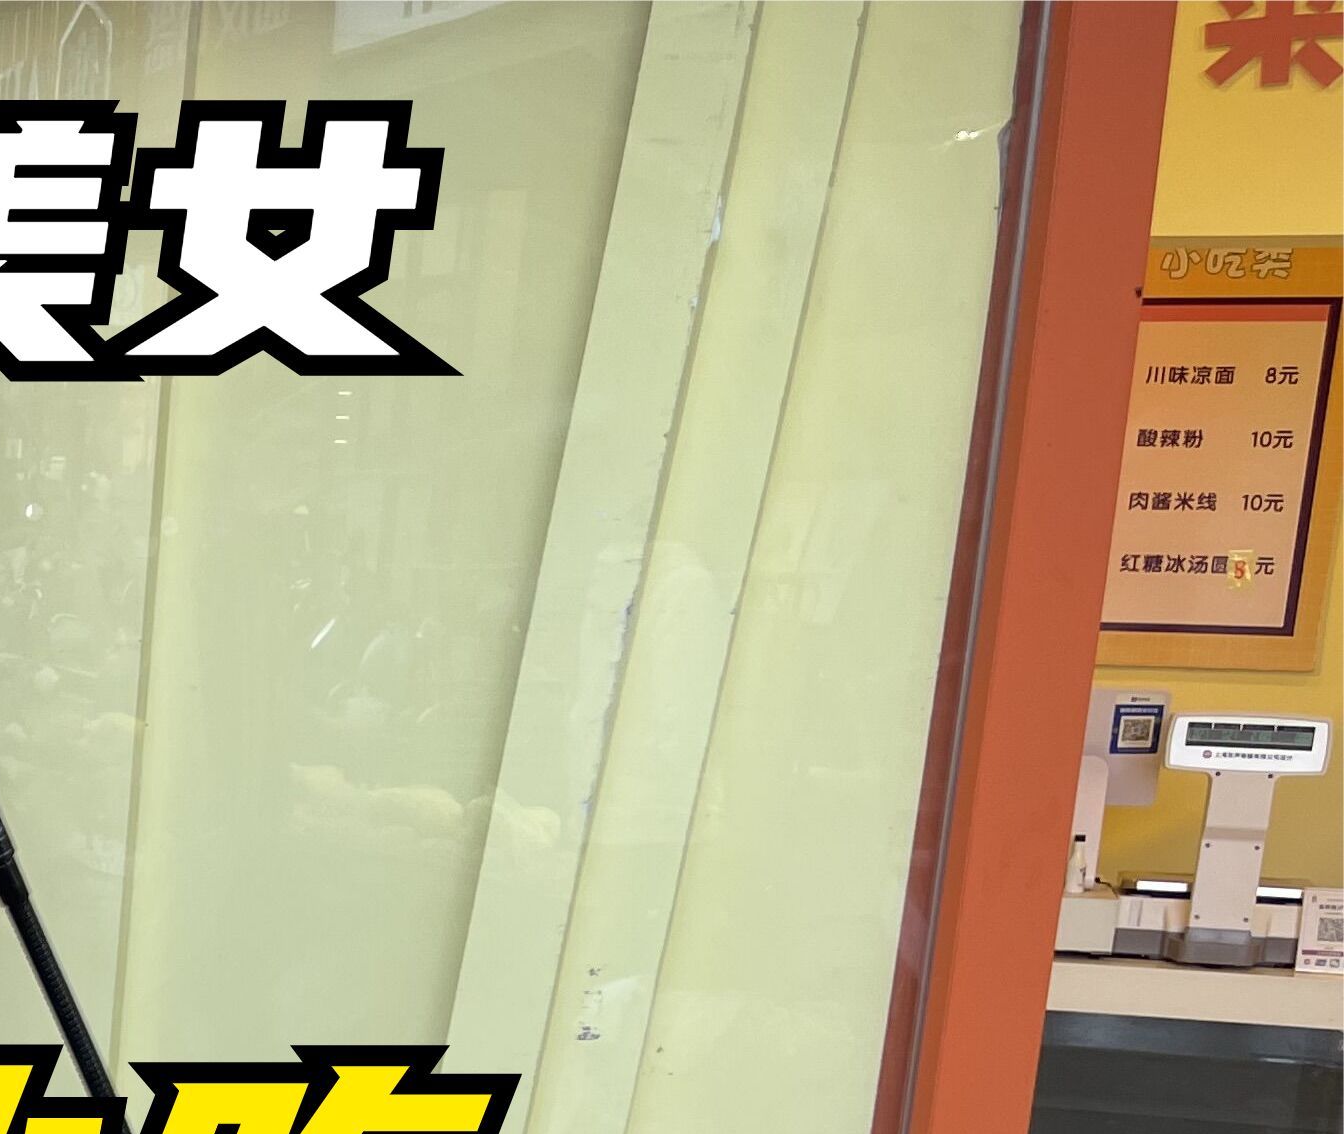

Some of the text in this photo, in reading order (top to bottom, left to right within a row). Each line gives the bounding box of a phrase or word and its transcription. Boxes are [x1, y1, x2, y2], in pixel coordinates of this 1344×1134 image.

[1145, 365, 1300, 386] 川味凉面 8元
[1136, 428, 1294, 449] 酸辣粉 10元
[1128, 491, 1285, 512] 肉酱米线 10元
[1120, 553, 1228, 575] 红糖冰汤圆
